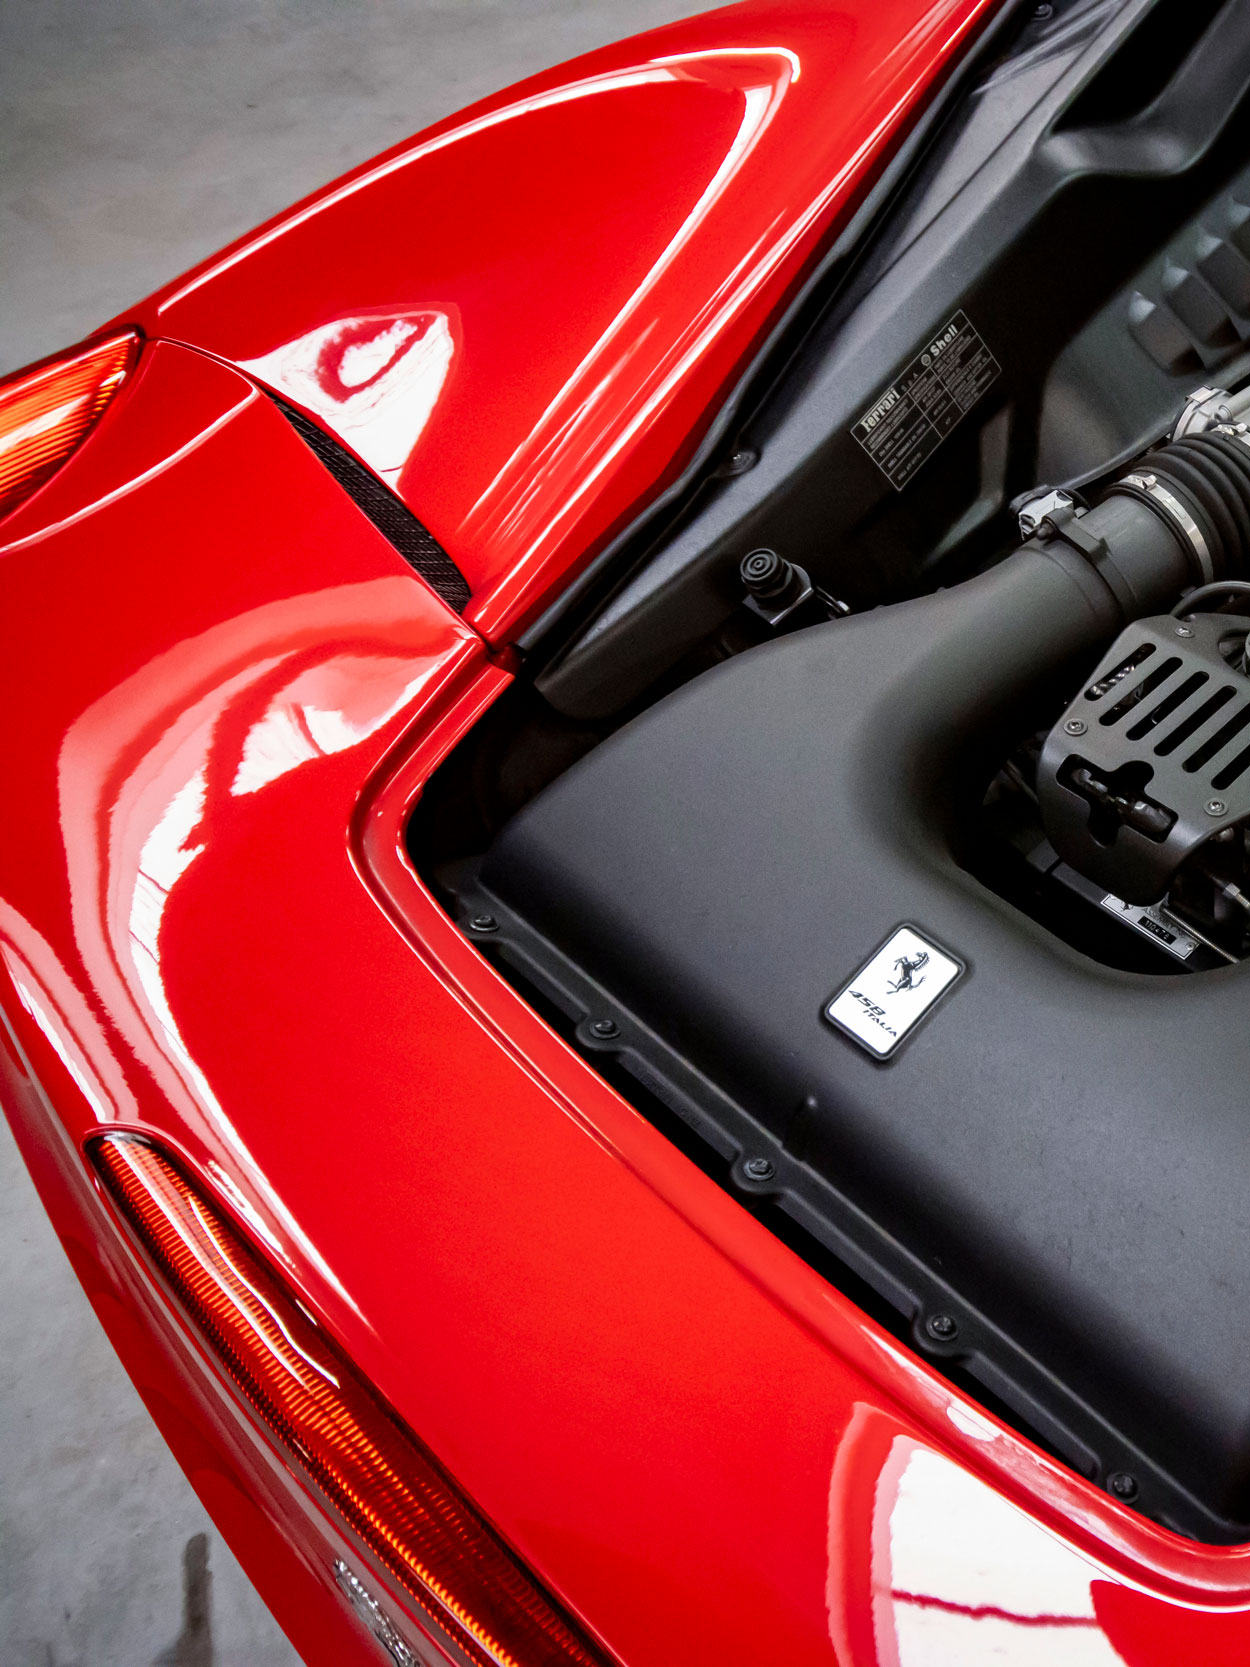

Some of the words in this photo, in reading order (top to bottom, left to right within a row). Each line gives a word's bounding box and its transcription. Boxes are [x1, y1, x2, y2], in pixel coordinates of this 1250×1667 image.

[860, 387, 901, 433] Ferrari
[929, 324, 959, 357] Shell
[848, 989, 887, 1017] 458
[862, 1009, 898, 1038] ITALIA
